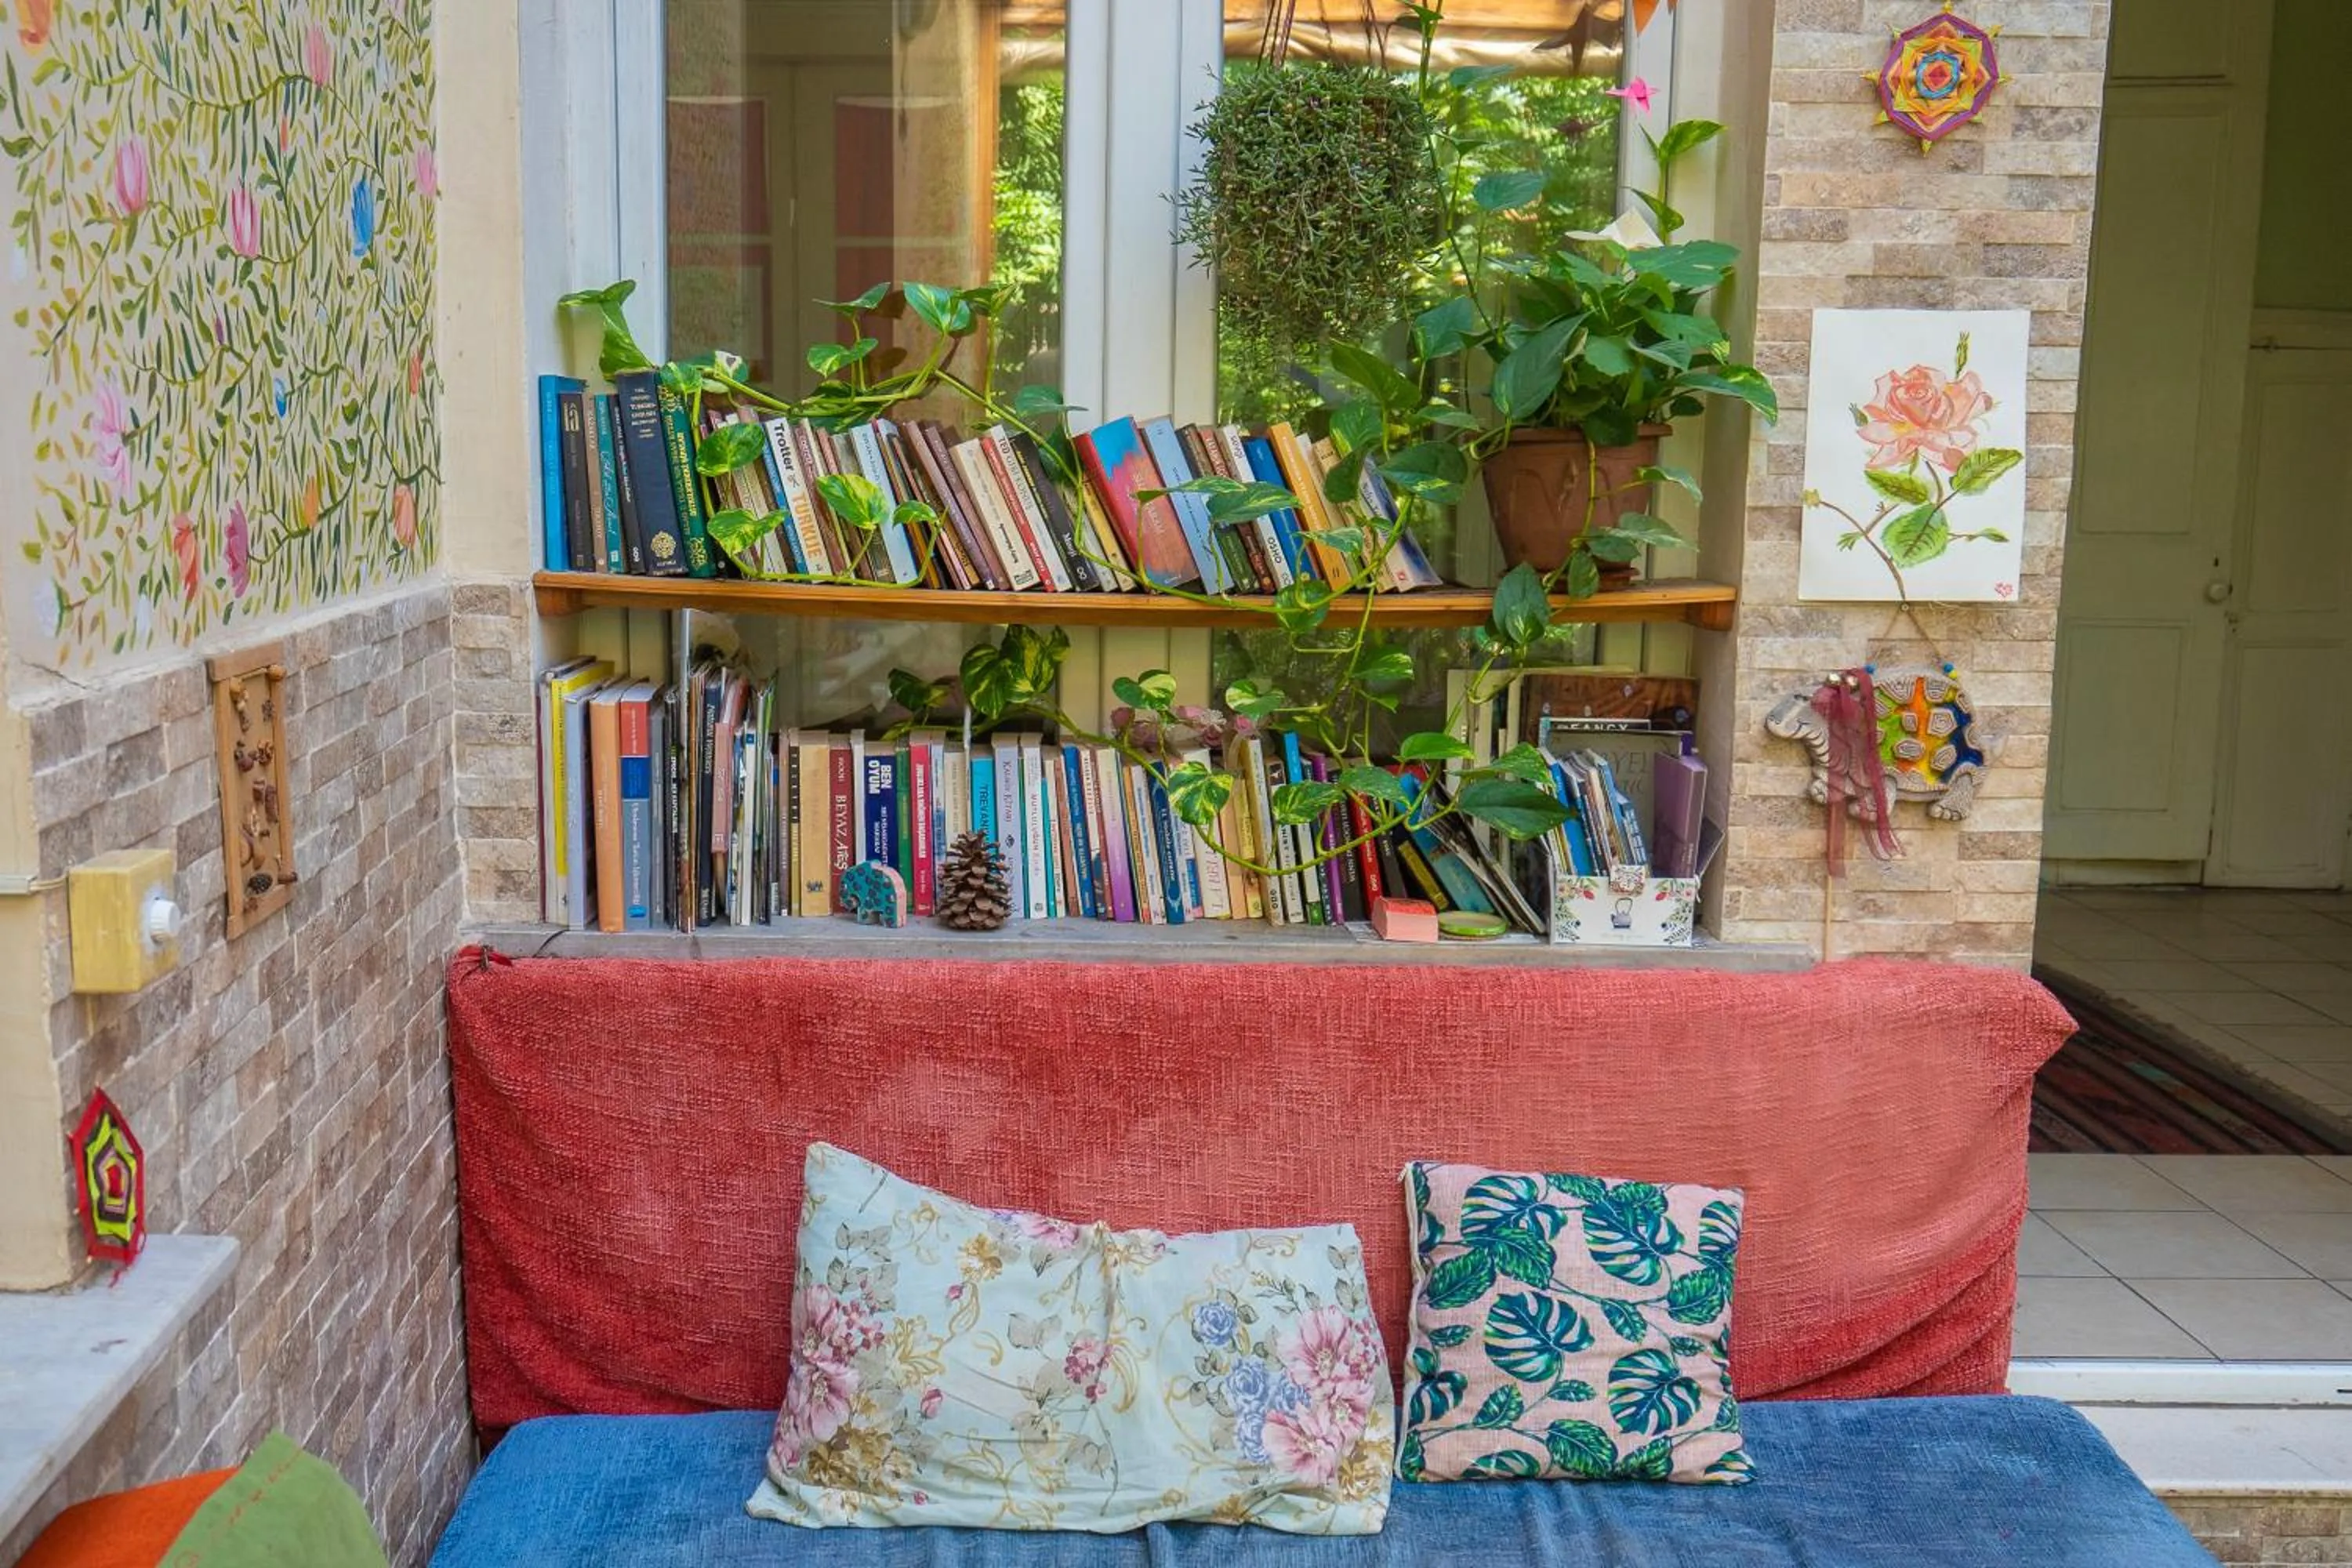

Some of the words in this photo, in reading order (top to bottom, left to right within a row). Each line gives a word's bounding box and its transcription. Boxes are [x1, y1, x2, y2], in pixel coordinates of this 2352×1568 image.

[774, 423, 794, 472] Trotter
[998, 437, 1011, 454] TED
[1267, 537, 1283, 564] OSHO
[869, 760, 880, 794] OYUM
[880, 764, 892, 789] BEN
[835, 794, 848, 839] BEYAZ
